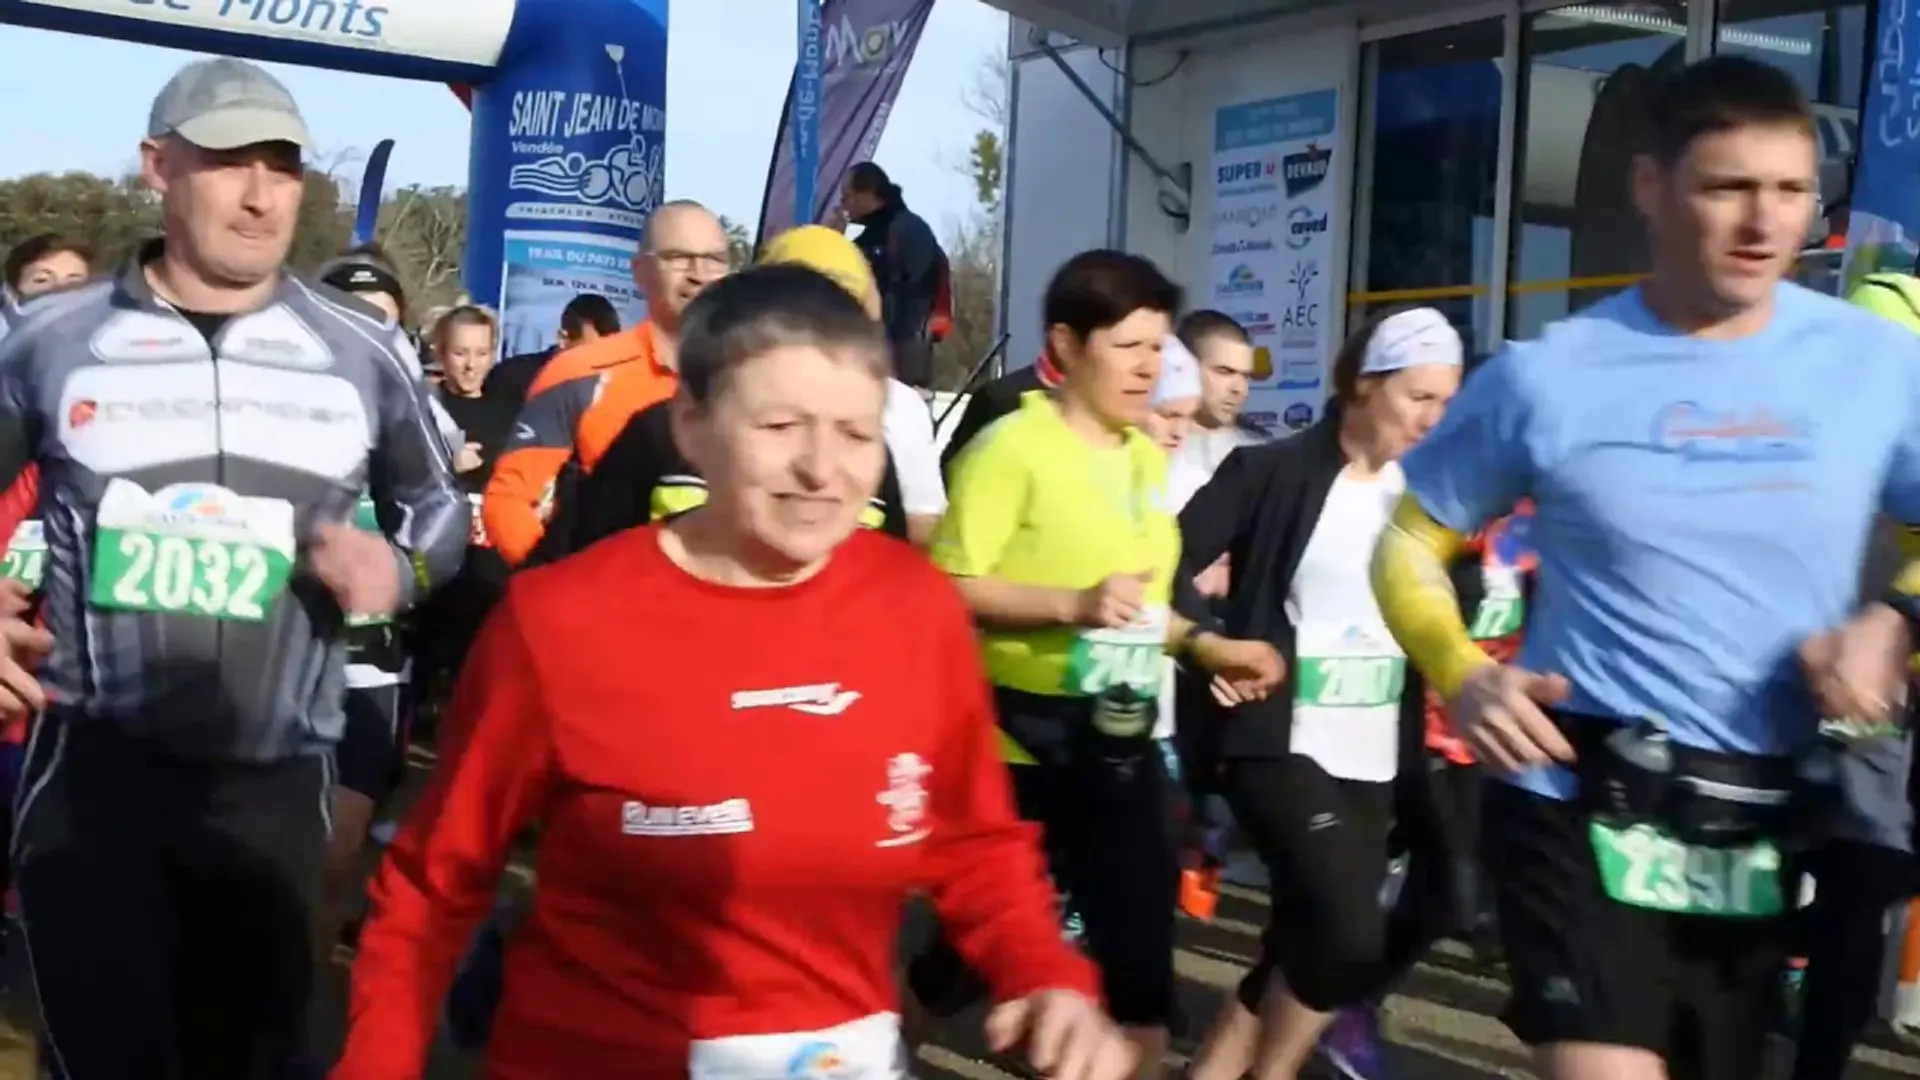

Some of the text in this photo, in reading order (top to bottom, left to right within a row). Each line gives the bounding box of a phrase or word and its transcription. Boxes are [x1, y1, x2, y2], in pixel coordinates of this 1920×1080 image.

[509, 91, 566, 136] SAINT
[564, 93, 615, 138] JEAN
[618, 97, 640, 130] DE
[512, 141, 564, 154] Vendée
[1217, 162, 1261, 183] SUPER
[528, 247, 562, 260] TRAIL
[566, 250, 585, 263] DU
[1282, 304, 1318, 327] AEC
[113, 531, 269, 619] 2032
